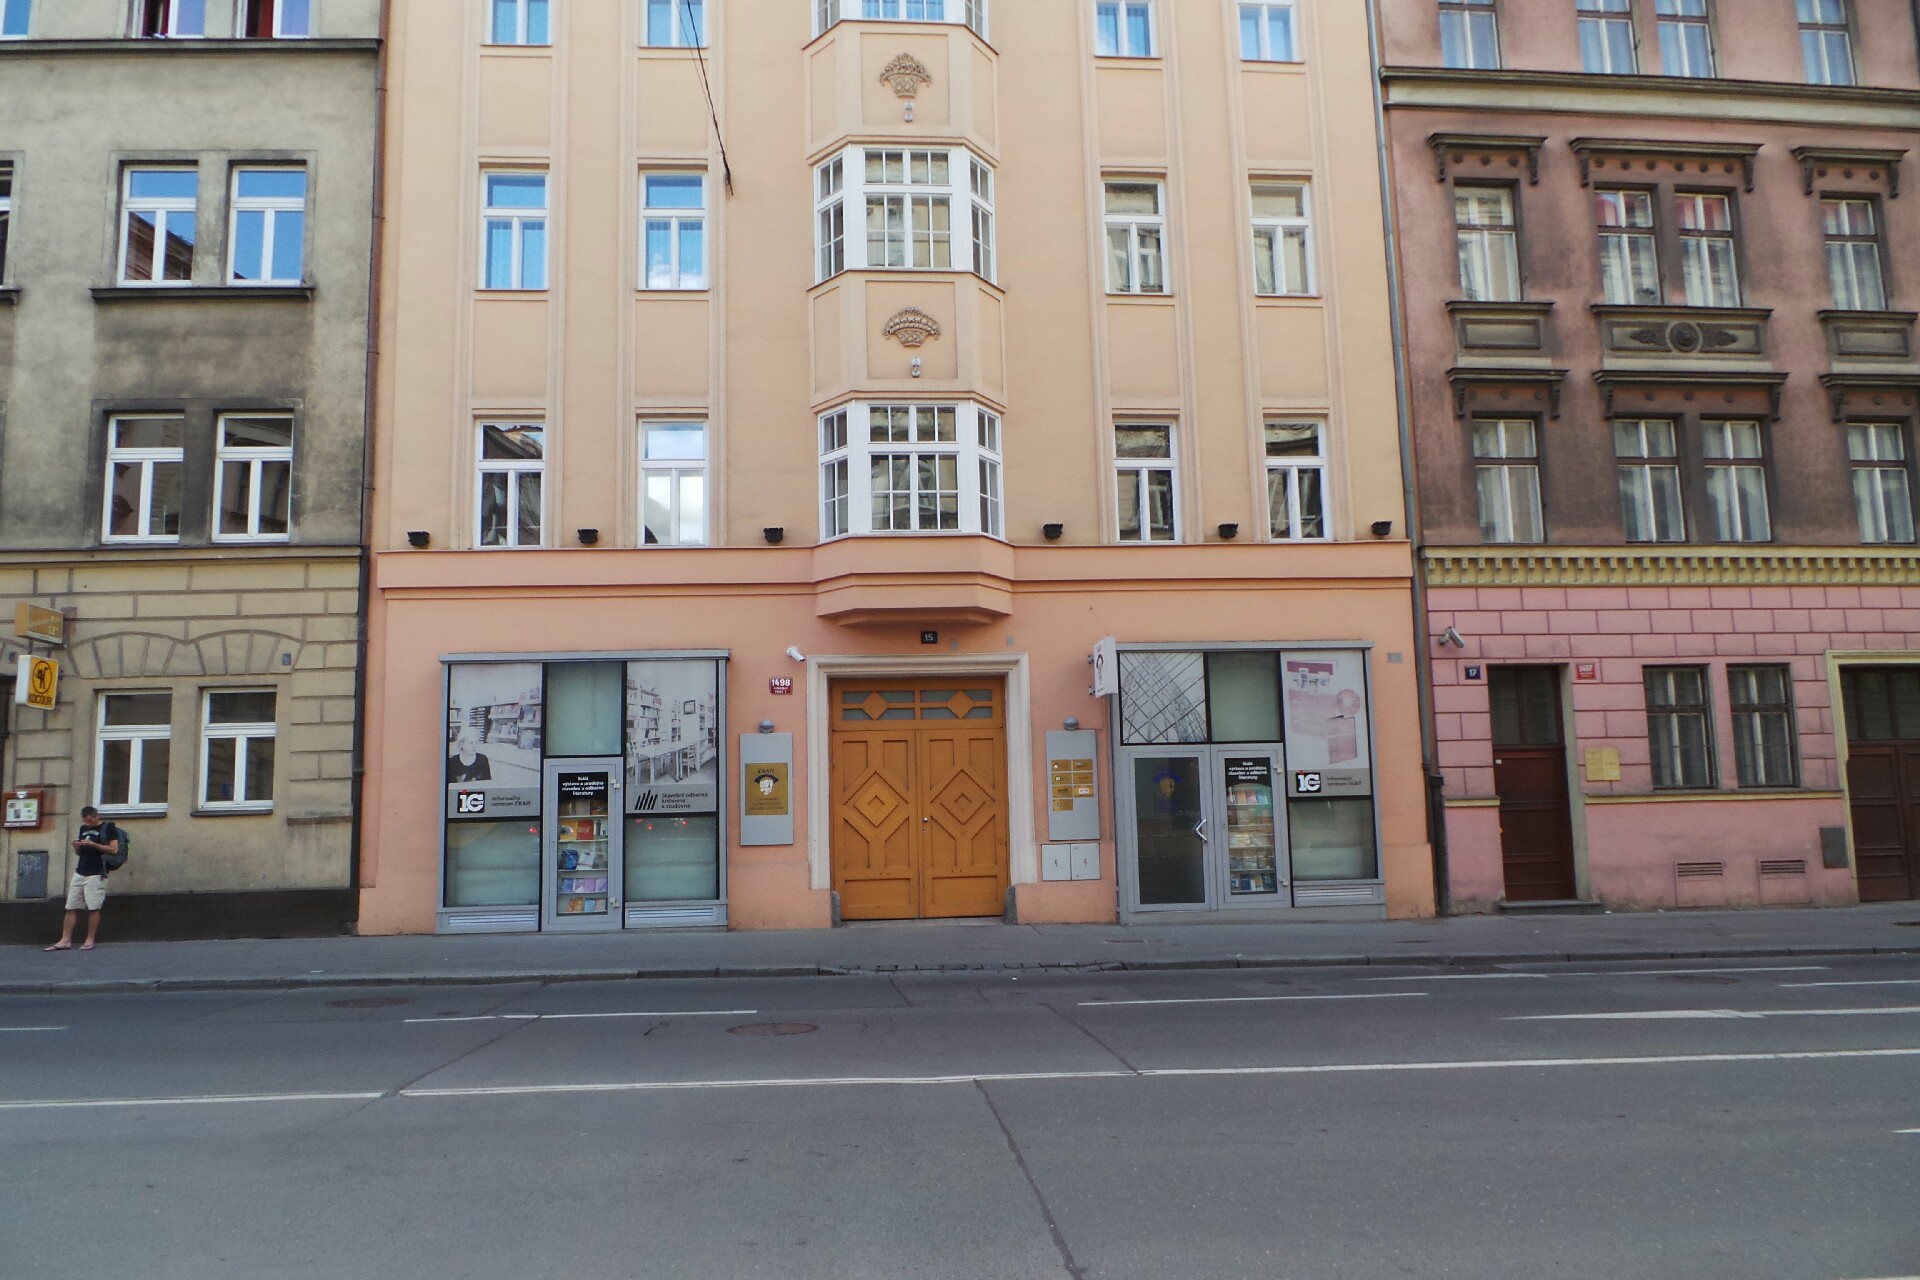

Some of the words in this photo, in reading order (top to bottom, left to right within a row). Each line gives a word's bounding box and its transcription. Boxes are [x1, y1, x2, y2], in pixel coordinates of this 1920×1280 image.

[924, 633, 934, 641] 15
[1469, 668, 1477, 677] 17
[772, 678, 790, 686] 1498
